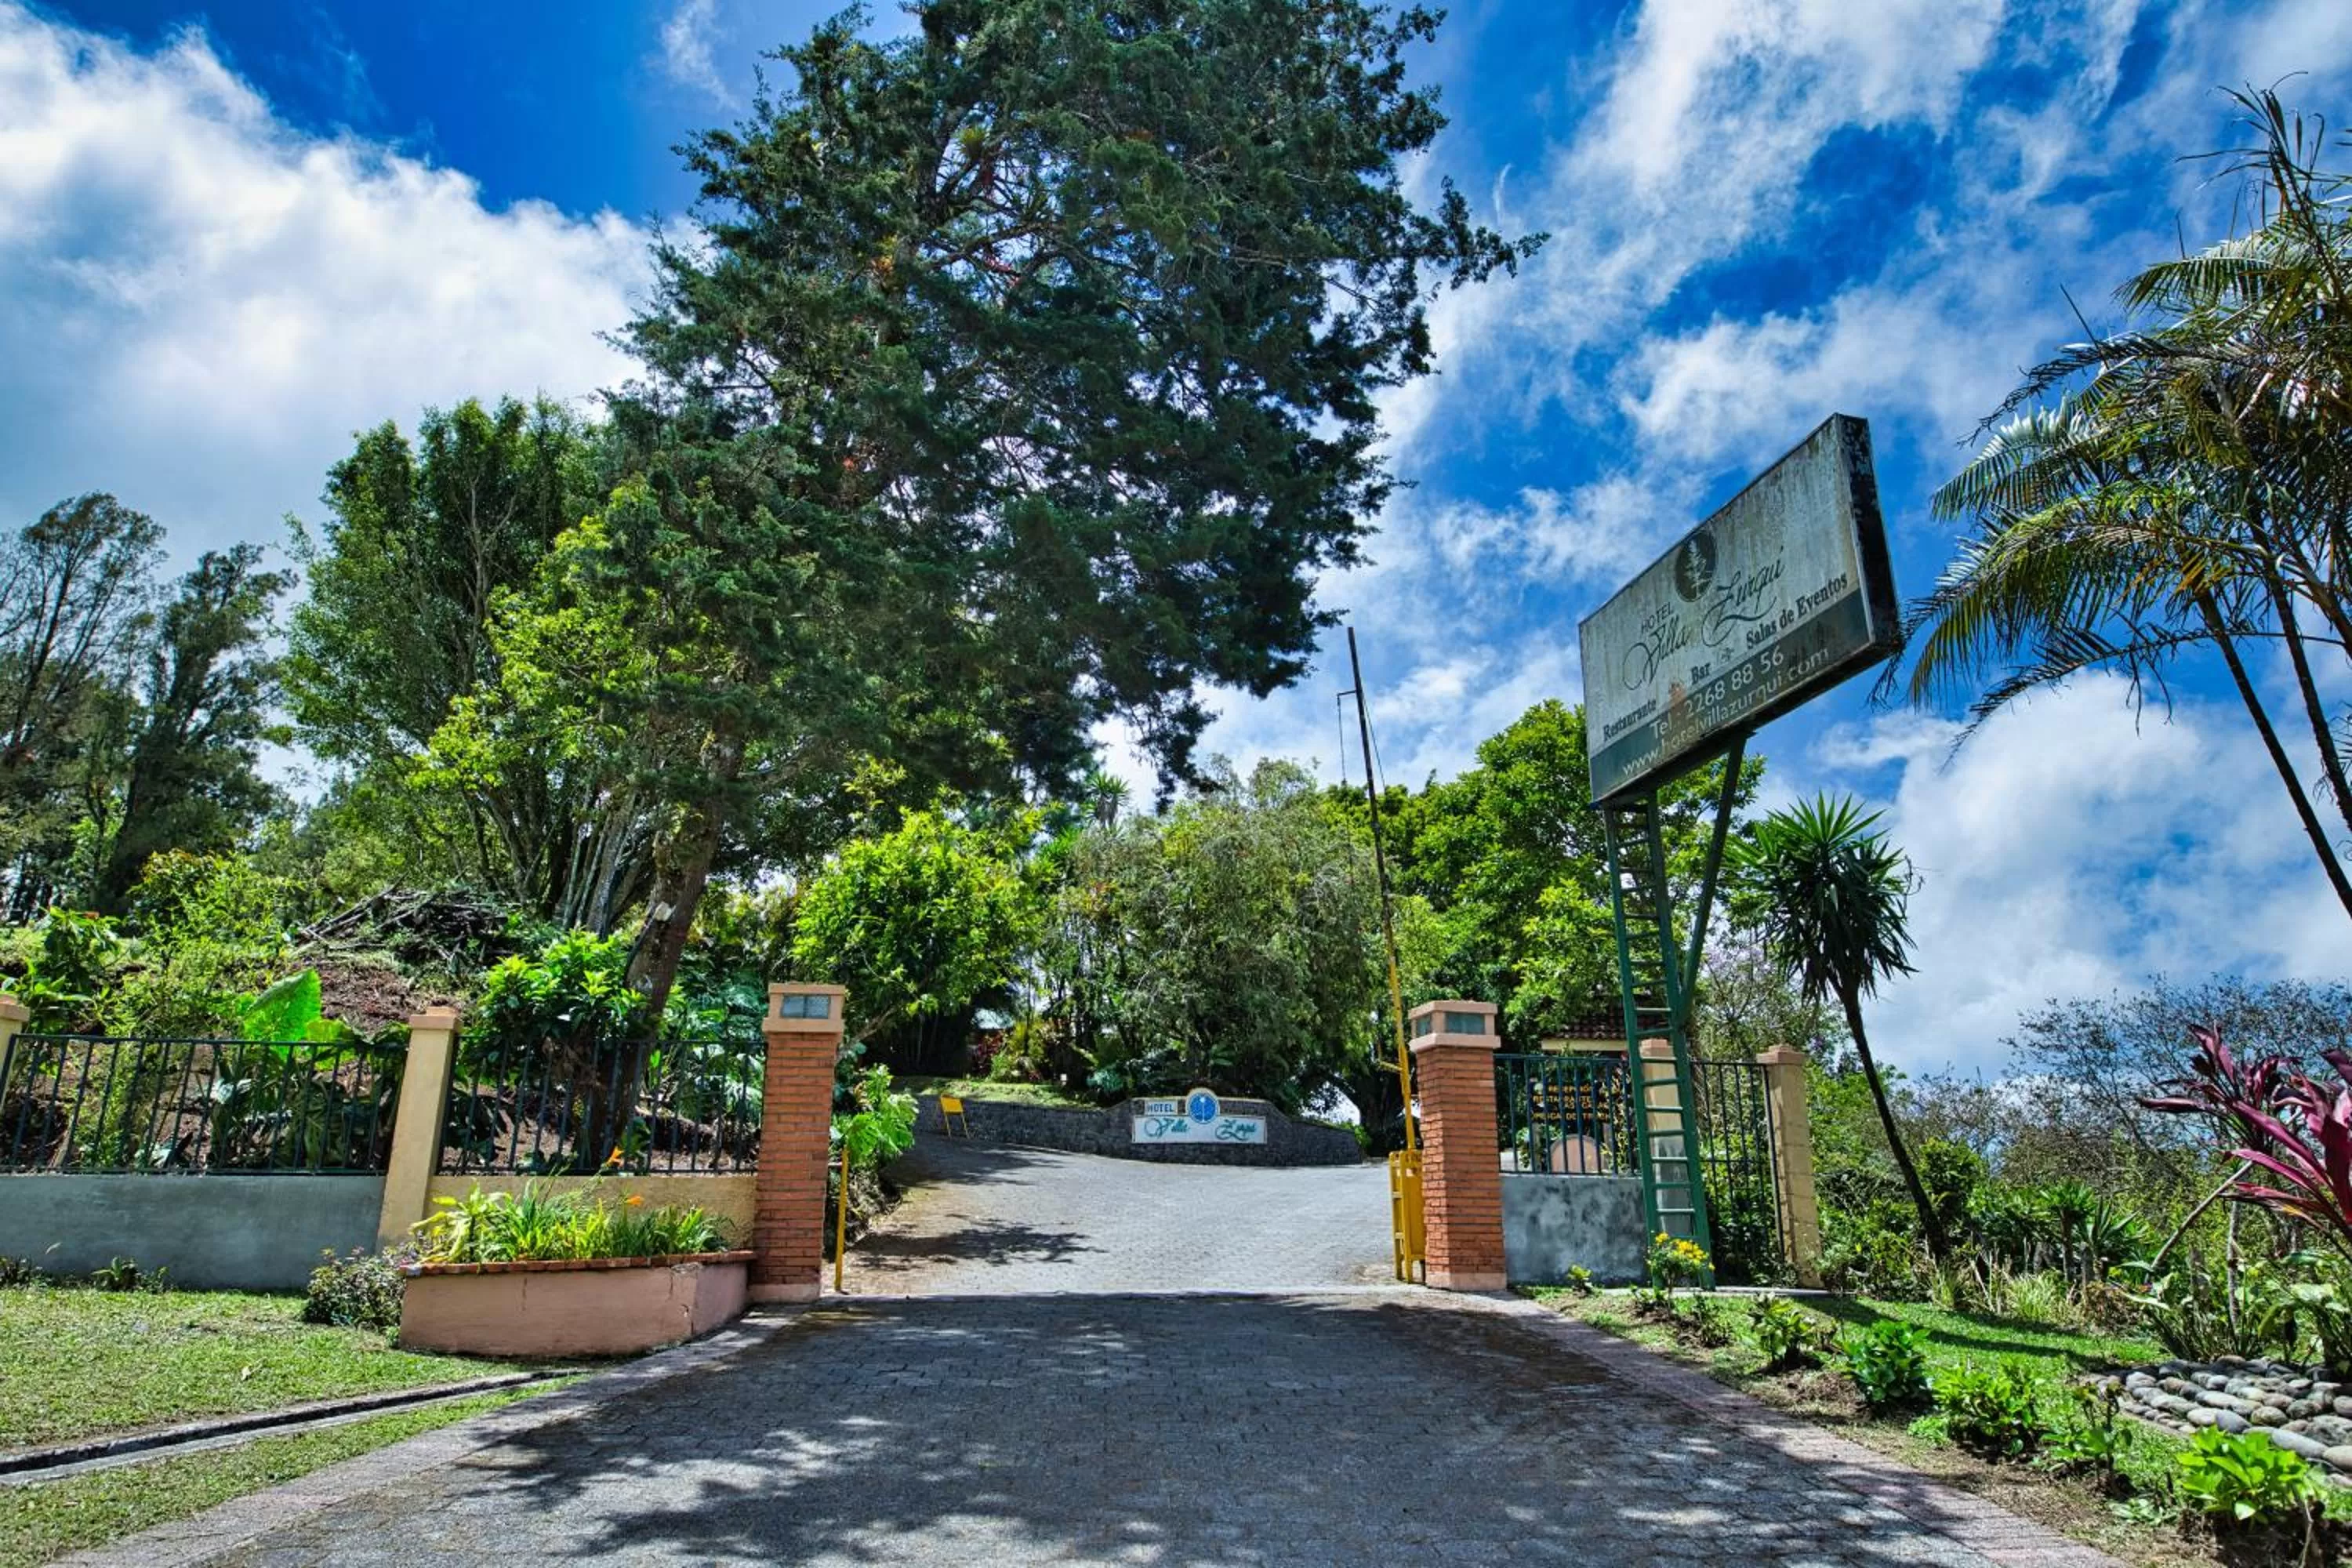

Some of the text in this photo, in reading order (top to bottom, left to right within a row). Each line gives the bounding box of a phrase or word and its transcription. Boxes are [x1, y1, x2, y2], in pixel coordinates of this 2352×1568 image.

[1641, 601, 1673, 634] HOTEL
[1745, 572, 1848, 650] Salas de Eventos
[1623, 614, 1690, 690] Villa
[1686, 680, 1726, 719] 2268
[1730, 663, 1754, 691] 88
[1760, 644, 1784, 674] 56
[1691, 662, 1711, 686] Bar
[1602, 699, 1657, 742] Restaurante
[1147, 1103, 1174, 1112] HOTEL
